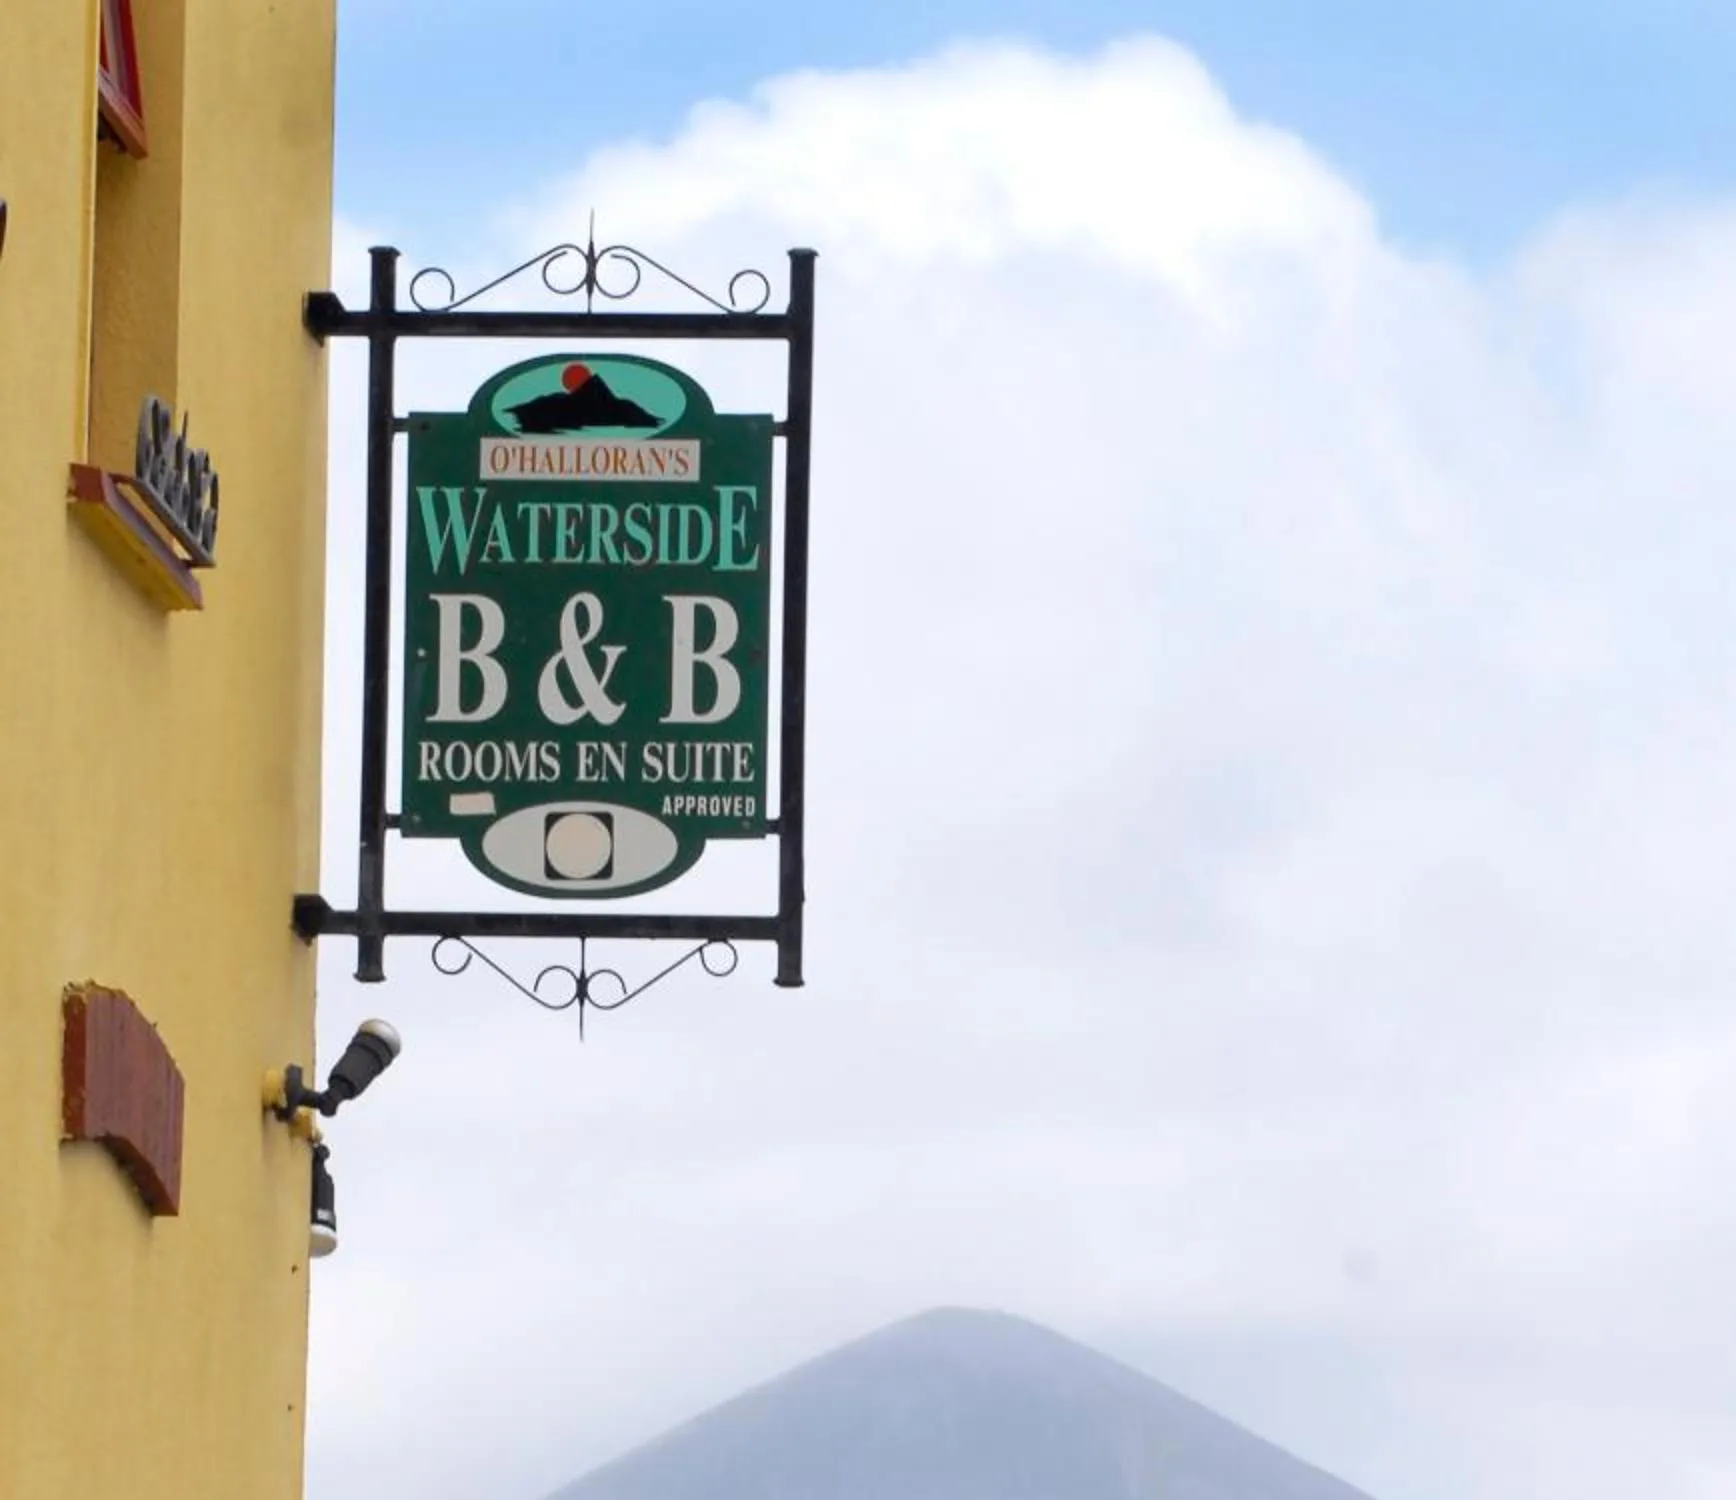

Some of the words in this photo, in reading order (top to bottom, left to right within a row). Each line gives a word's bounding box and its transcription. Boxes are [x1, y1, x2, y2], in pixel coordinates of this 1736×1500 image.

[489, 445, 691, 475] O'HALLORAN'S
[415, 485, 760, 575] WATERSIDE
[425, 593, 509, 723] B
[538, 591, 627, 725] &
[659, 594, 741, 724] B
[418, 740, 561, 782] ROOMS
[576, 741, 628, 782] EN
[641, 741, 755, 783] SUITE
[662, 795, 756, 817] APPROVED
